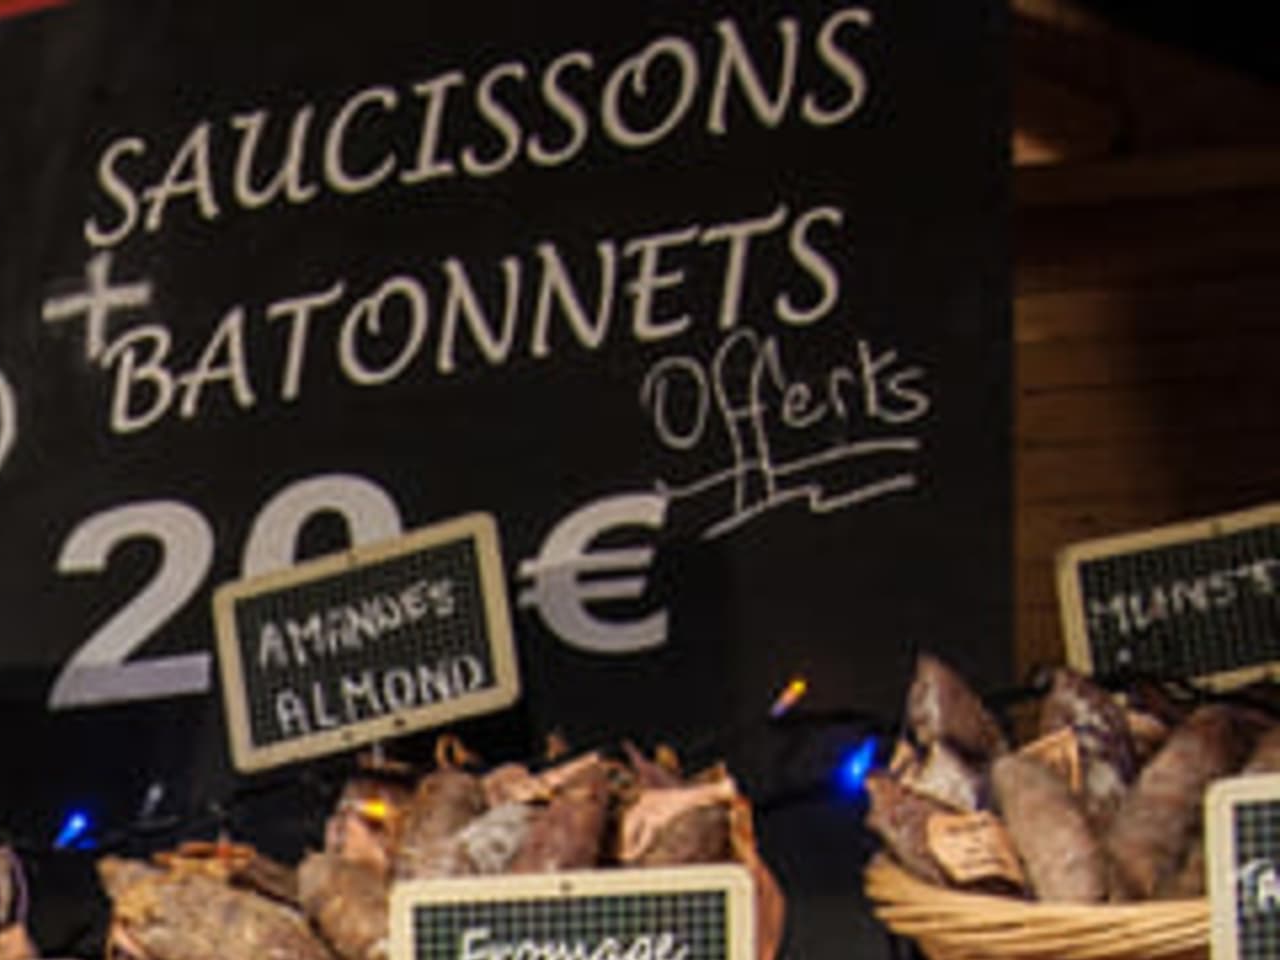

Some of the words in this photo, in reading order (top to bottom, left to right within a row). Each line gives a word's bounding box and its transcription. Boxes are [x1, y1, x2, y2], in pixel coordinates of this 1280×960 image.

[83, 9, 871, 247] SAUCISSONS
[42, 251, 151, 359] +
[108, 206, 843, 434] BATONNETS
[640, 328, 930, 514] Offerts
[519, 492, 668, 655] €
[276, 653, 485, 735] ALMOND
